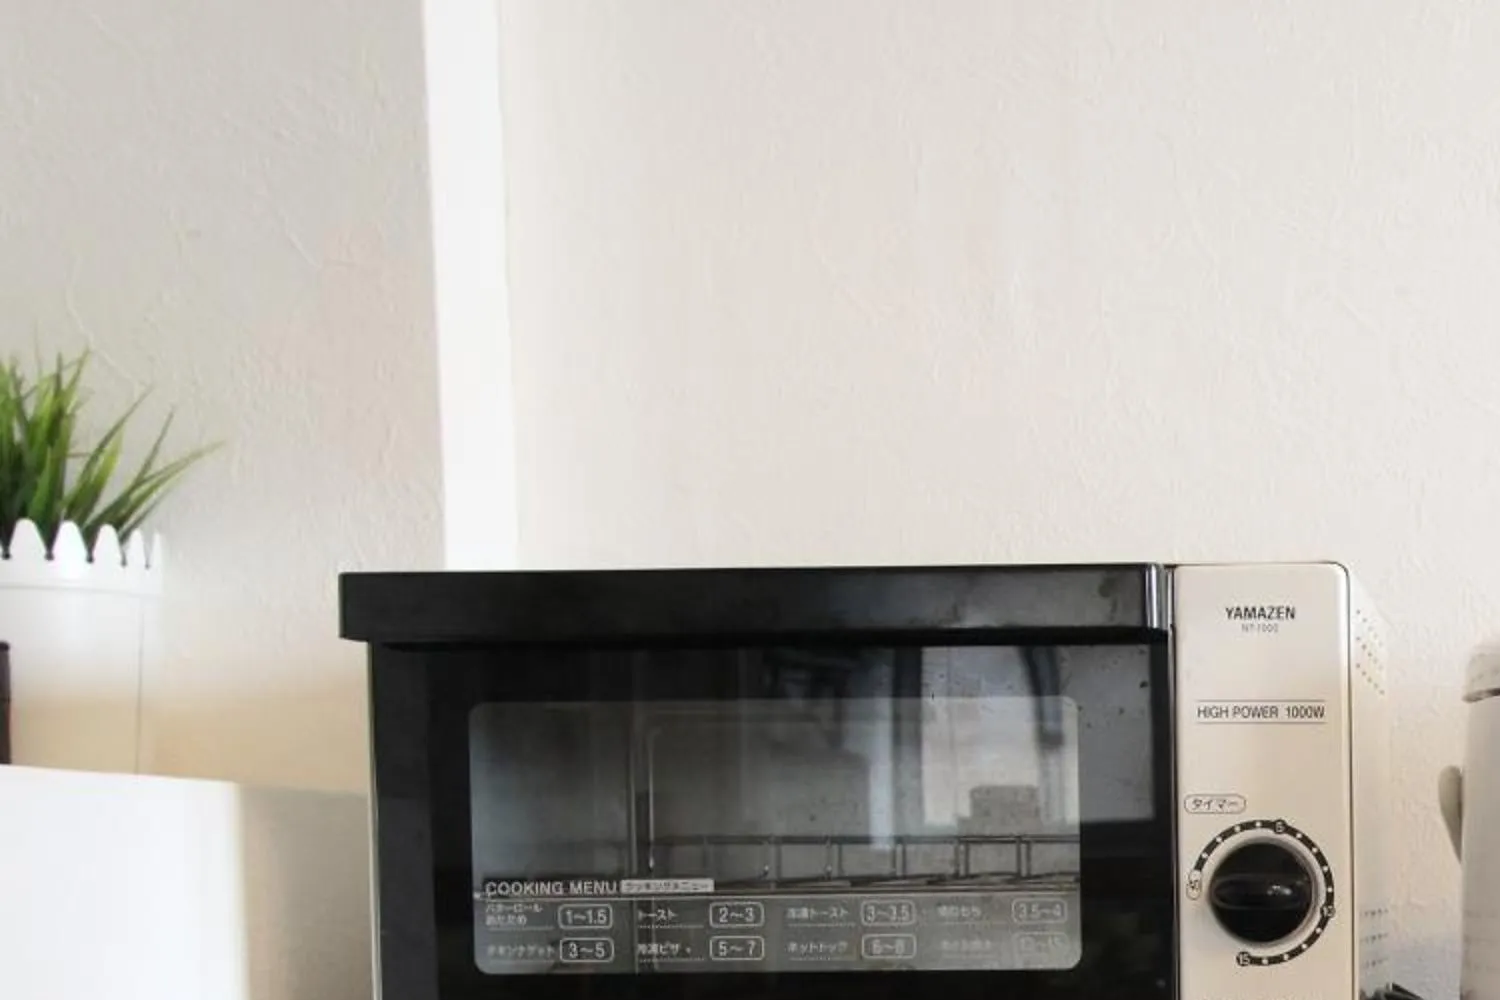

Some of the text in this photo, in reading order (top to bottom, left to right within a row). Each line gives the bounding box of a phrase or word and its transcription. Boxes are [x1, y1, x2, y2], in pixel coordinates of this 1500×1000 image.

[1226, 606, 1296, 620] YAMAZEN
[1197, 706, 1325, 719] HIGH POWER 1000W
[1191, 798, 1239, 811] タイマー
[486, 880, 617, 896] COOKING MENU
